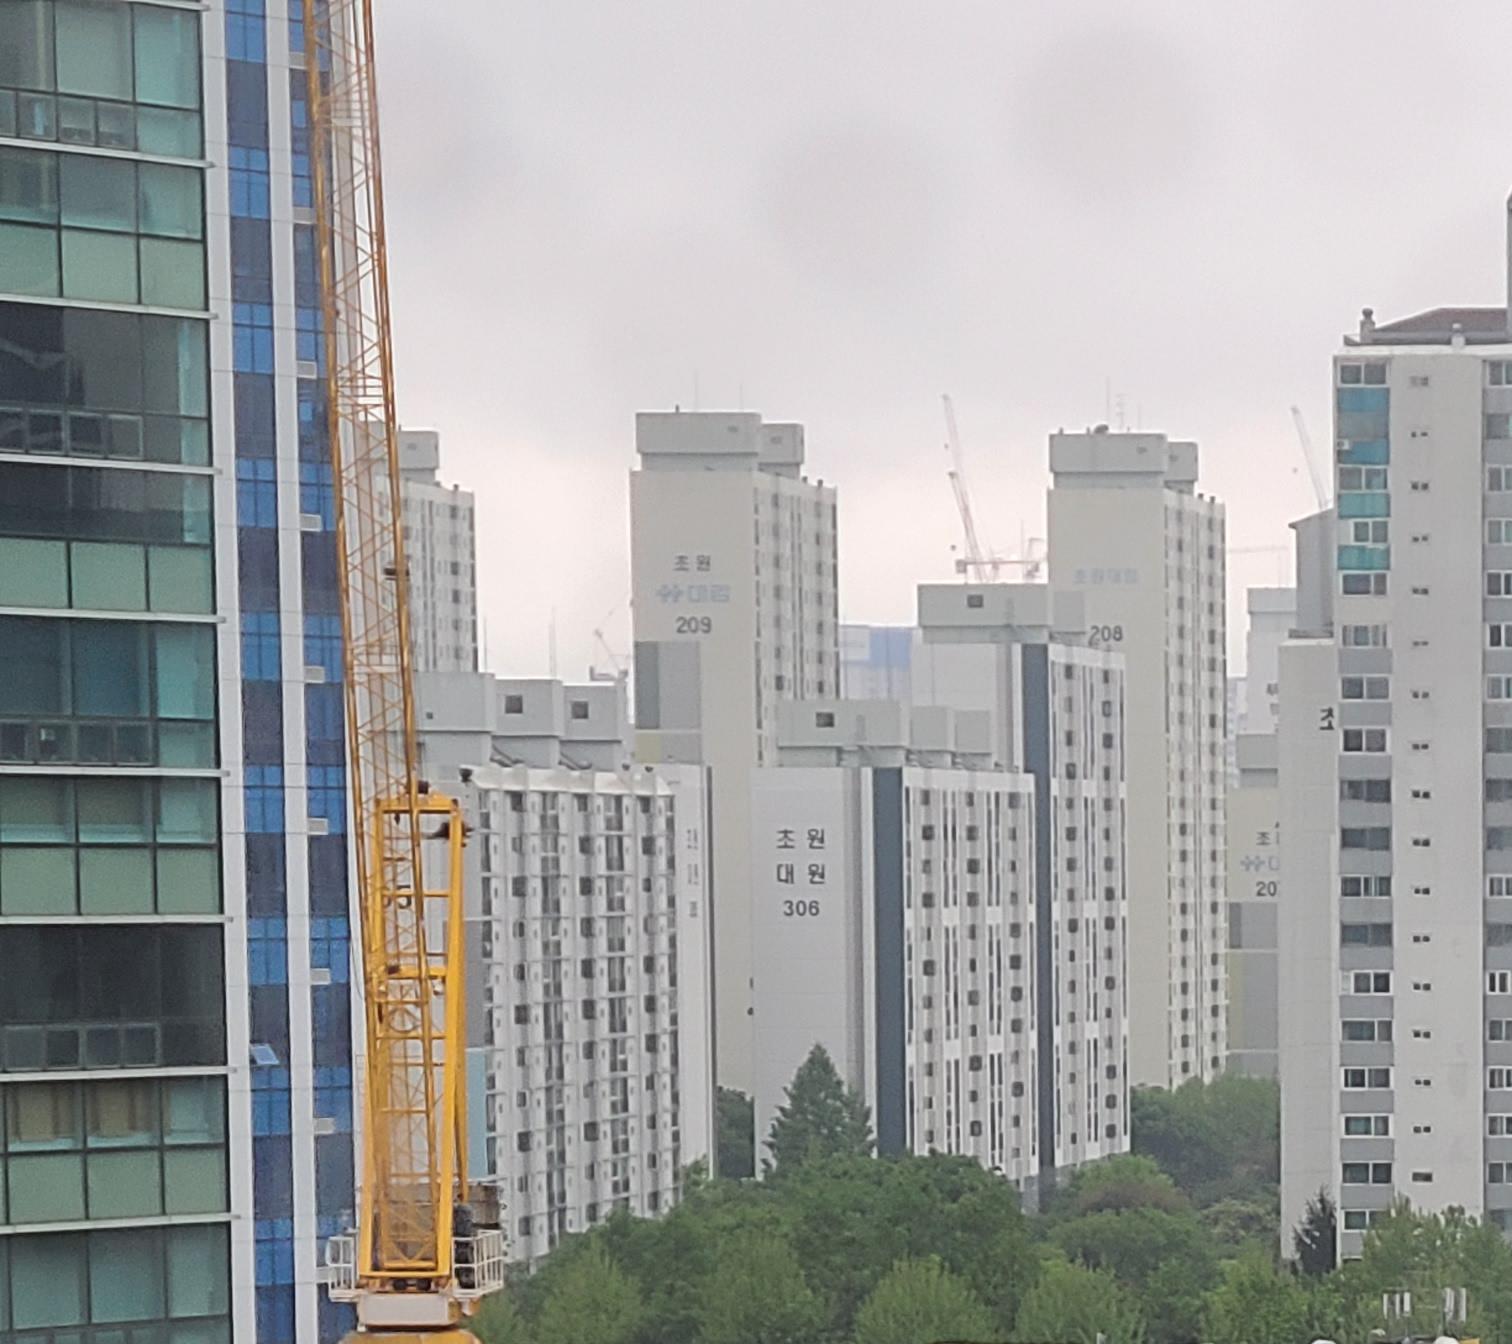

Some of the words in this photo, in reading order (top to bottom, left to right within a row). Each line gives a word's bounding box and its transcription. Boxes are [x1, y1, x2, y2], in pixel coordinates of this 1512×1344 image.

[675, 616, 712, 634] 209
[1088, 625, 1123, 644] 208
[776, 829, 825, 850] 초원
[776, 863, 825, 885] 대원
[783, 900, 820, 917] 306
